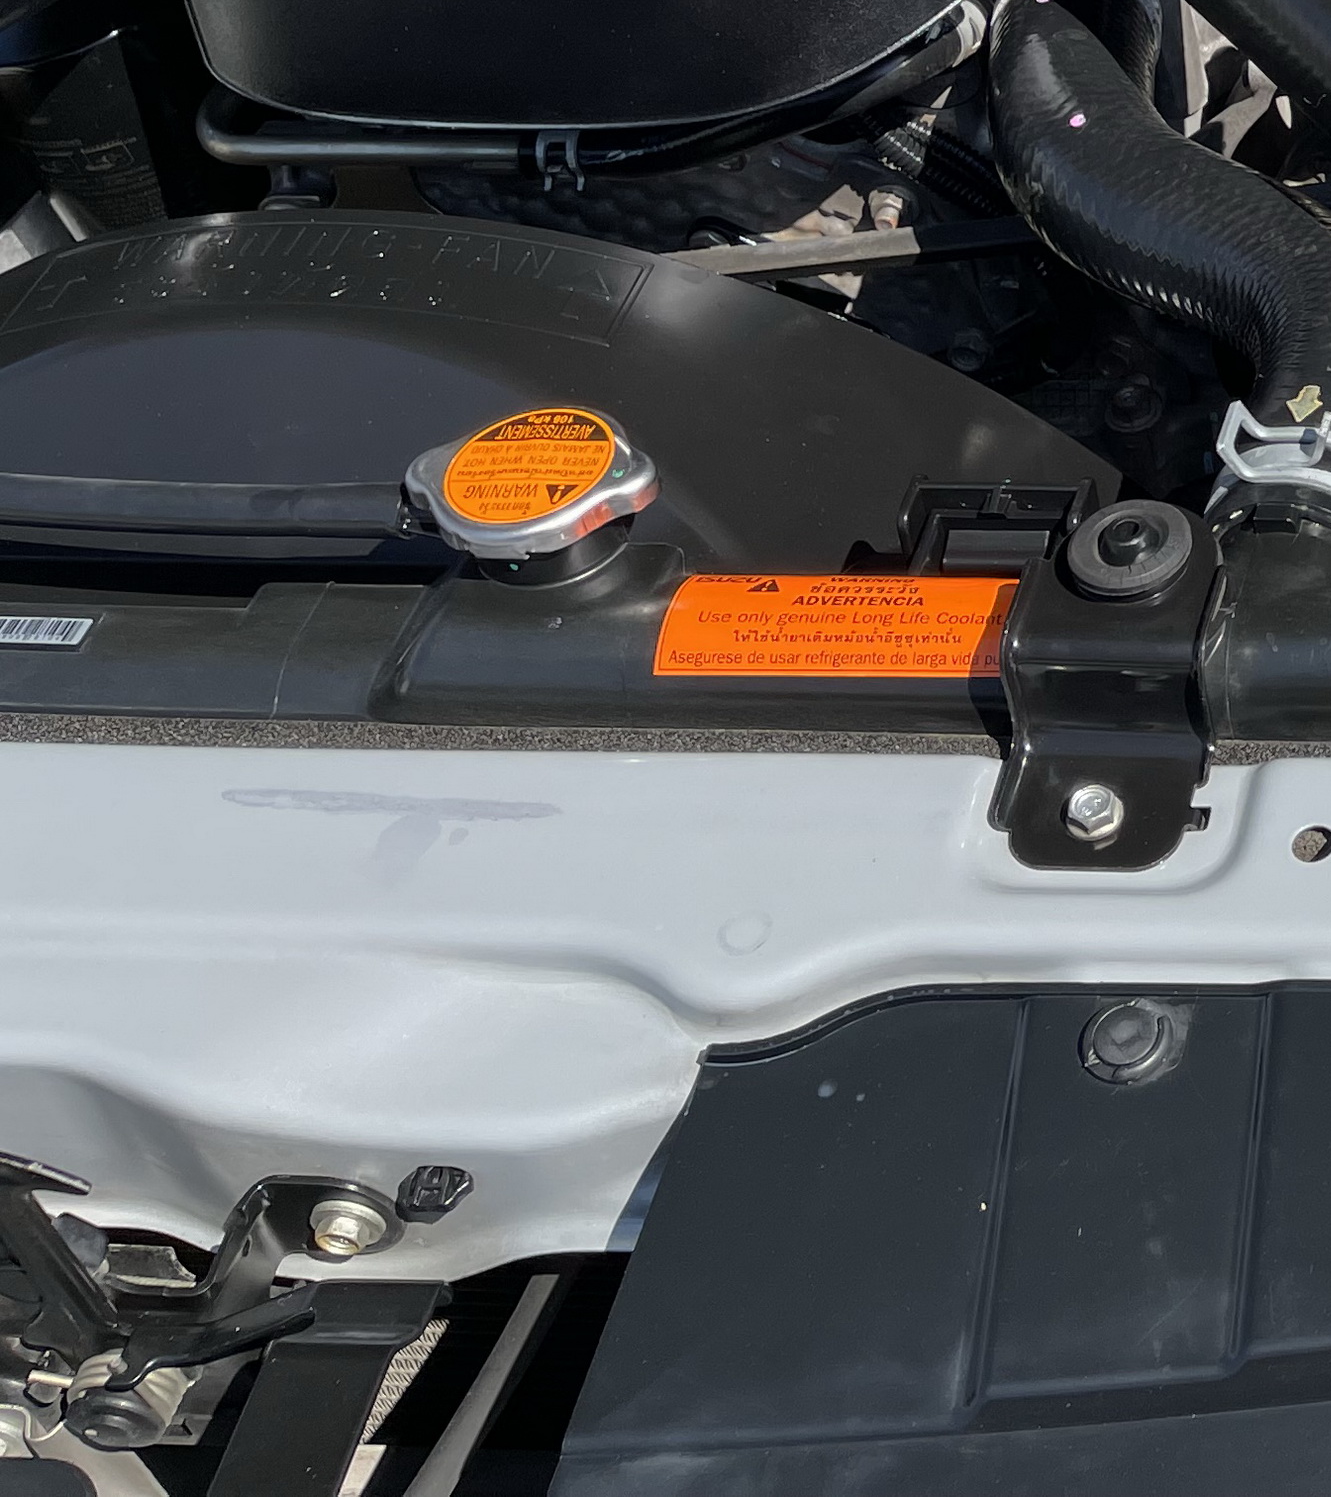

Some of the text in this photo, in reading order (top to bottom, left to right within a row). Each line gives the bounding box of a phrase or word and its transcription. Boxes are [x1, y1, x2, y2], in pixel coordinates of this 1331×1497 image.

[493, 424, 597, 440] AVERTISSEMENT
[462, 455, 600, 468] NEVER OPEN WHEN HOT
[463, 483, 539, 499] WARNING
[810, 583, 920, 595] ข้อควรระวัง
[791, 595, 925, 607] ADVERTENCIA
[698, 611, 1003, 627] Use only genuine Long Life Coolant
[668, 649, 743, 668] Asegurese
[747, 650, 765, 665] de
[769, 653, 800, 666] usar
[805, 649, 887, 668] refrigerante
[891, 650, 908, 665] de
[912, 650, 947, 669] larga
[952, 650, 980, 666] vida
